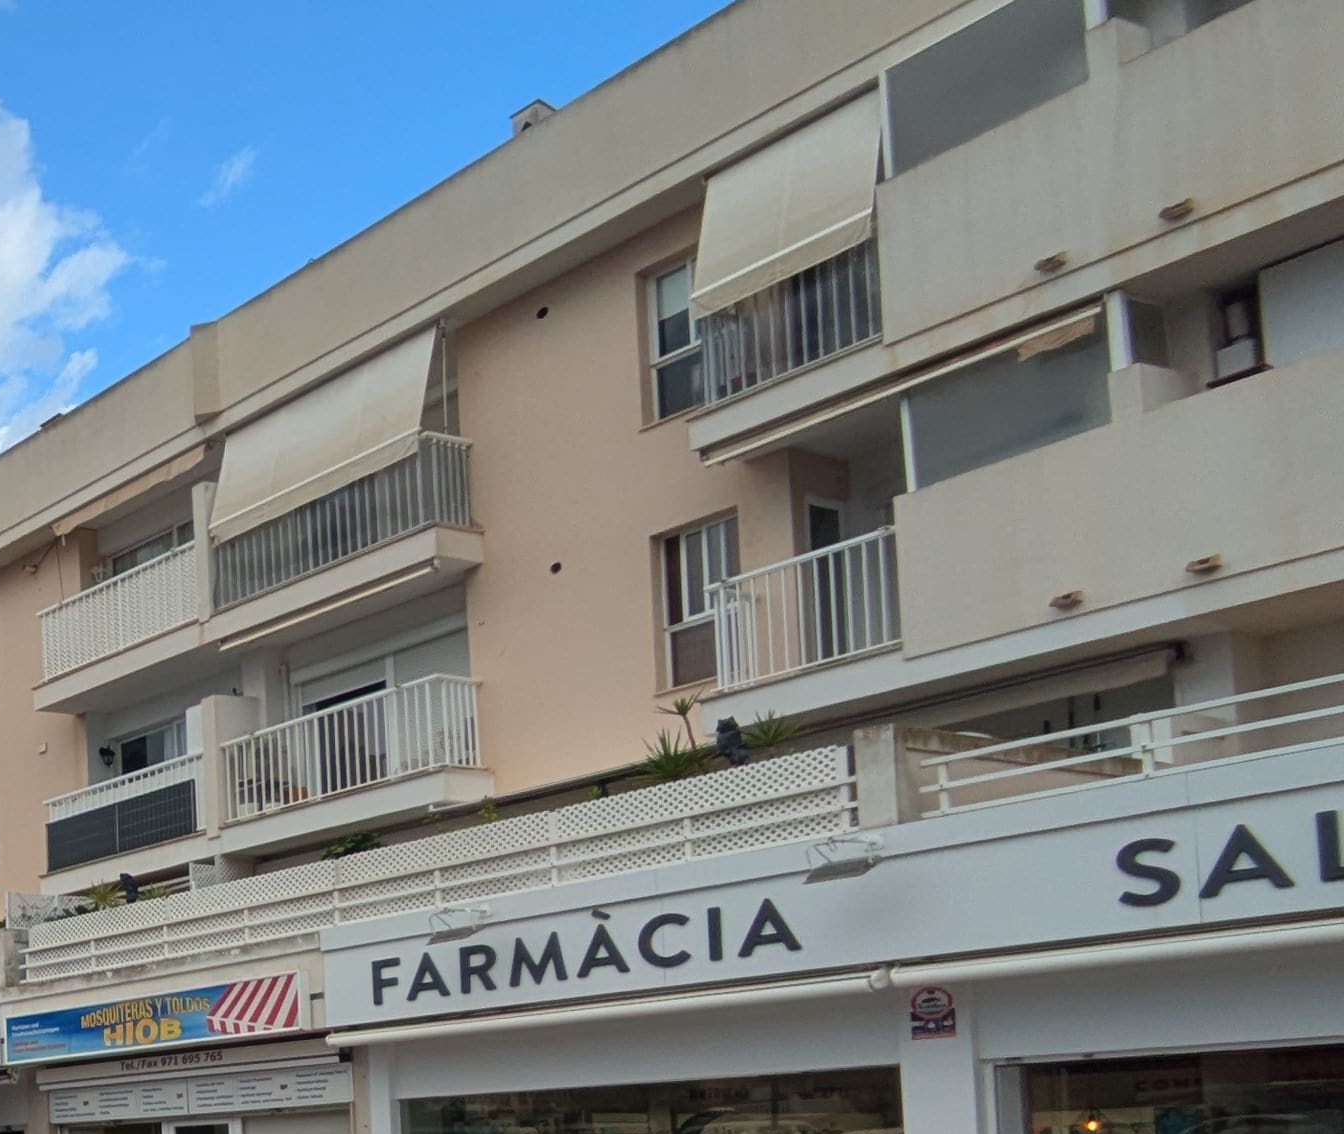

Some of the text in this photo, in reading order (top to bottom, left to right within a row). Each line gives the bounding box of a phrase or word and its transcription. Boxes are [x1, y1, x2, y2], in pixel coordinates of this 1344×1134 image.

[371, 897, 803, 1006] FARMÀCIA
[80, 996, 211, 1029] MOSQUITERAS Y TOLDOS
[103, 1017, 182, 1048] HIOB
[160, 1056, 179, 1069] 971
[181, 1053, 201, 1065] 695
[204, 1050, 223, 1062] 765
